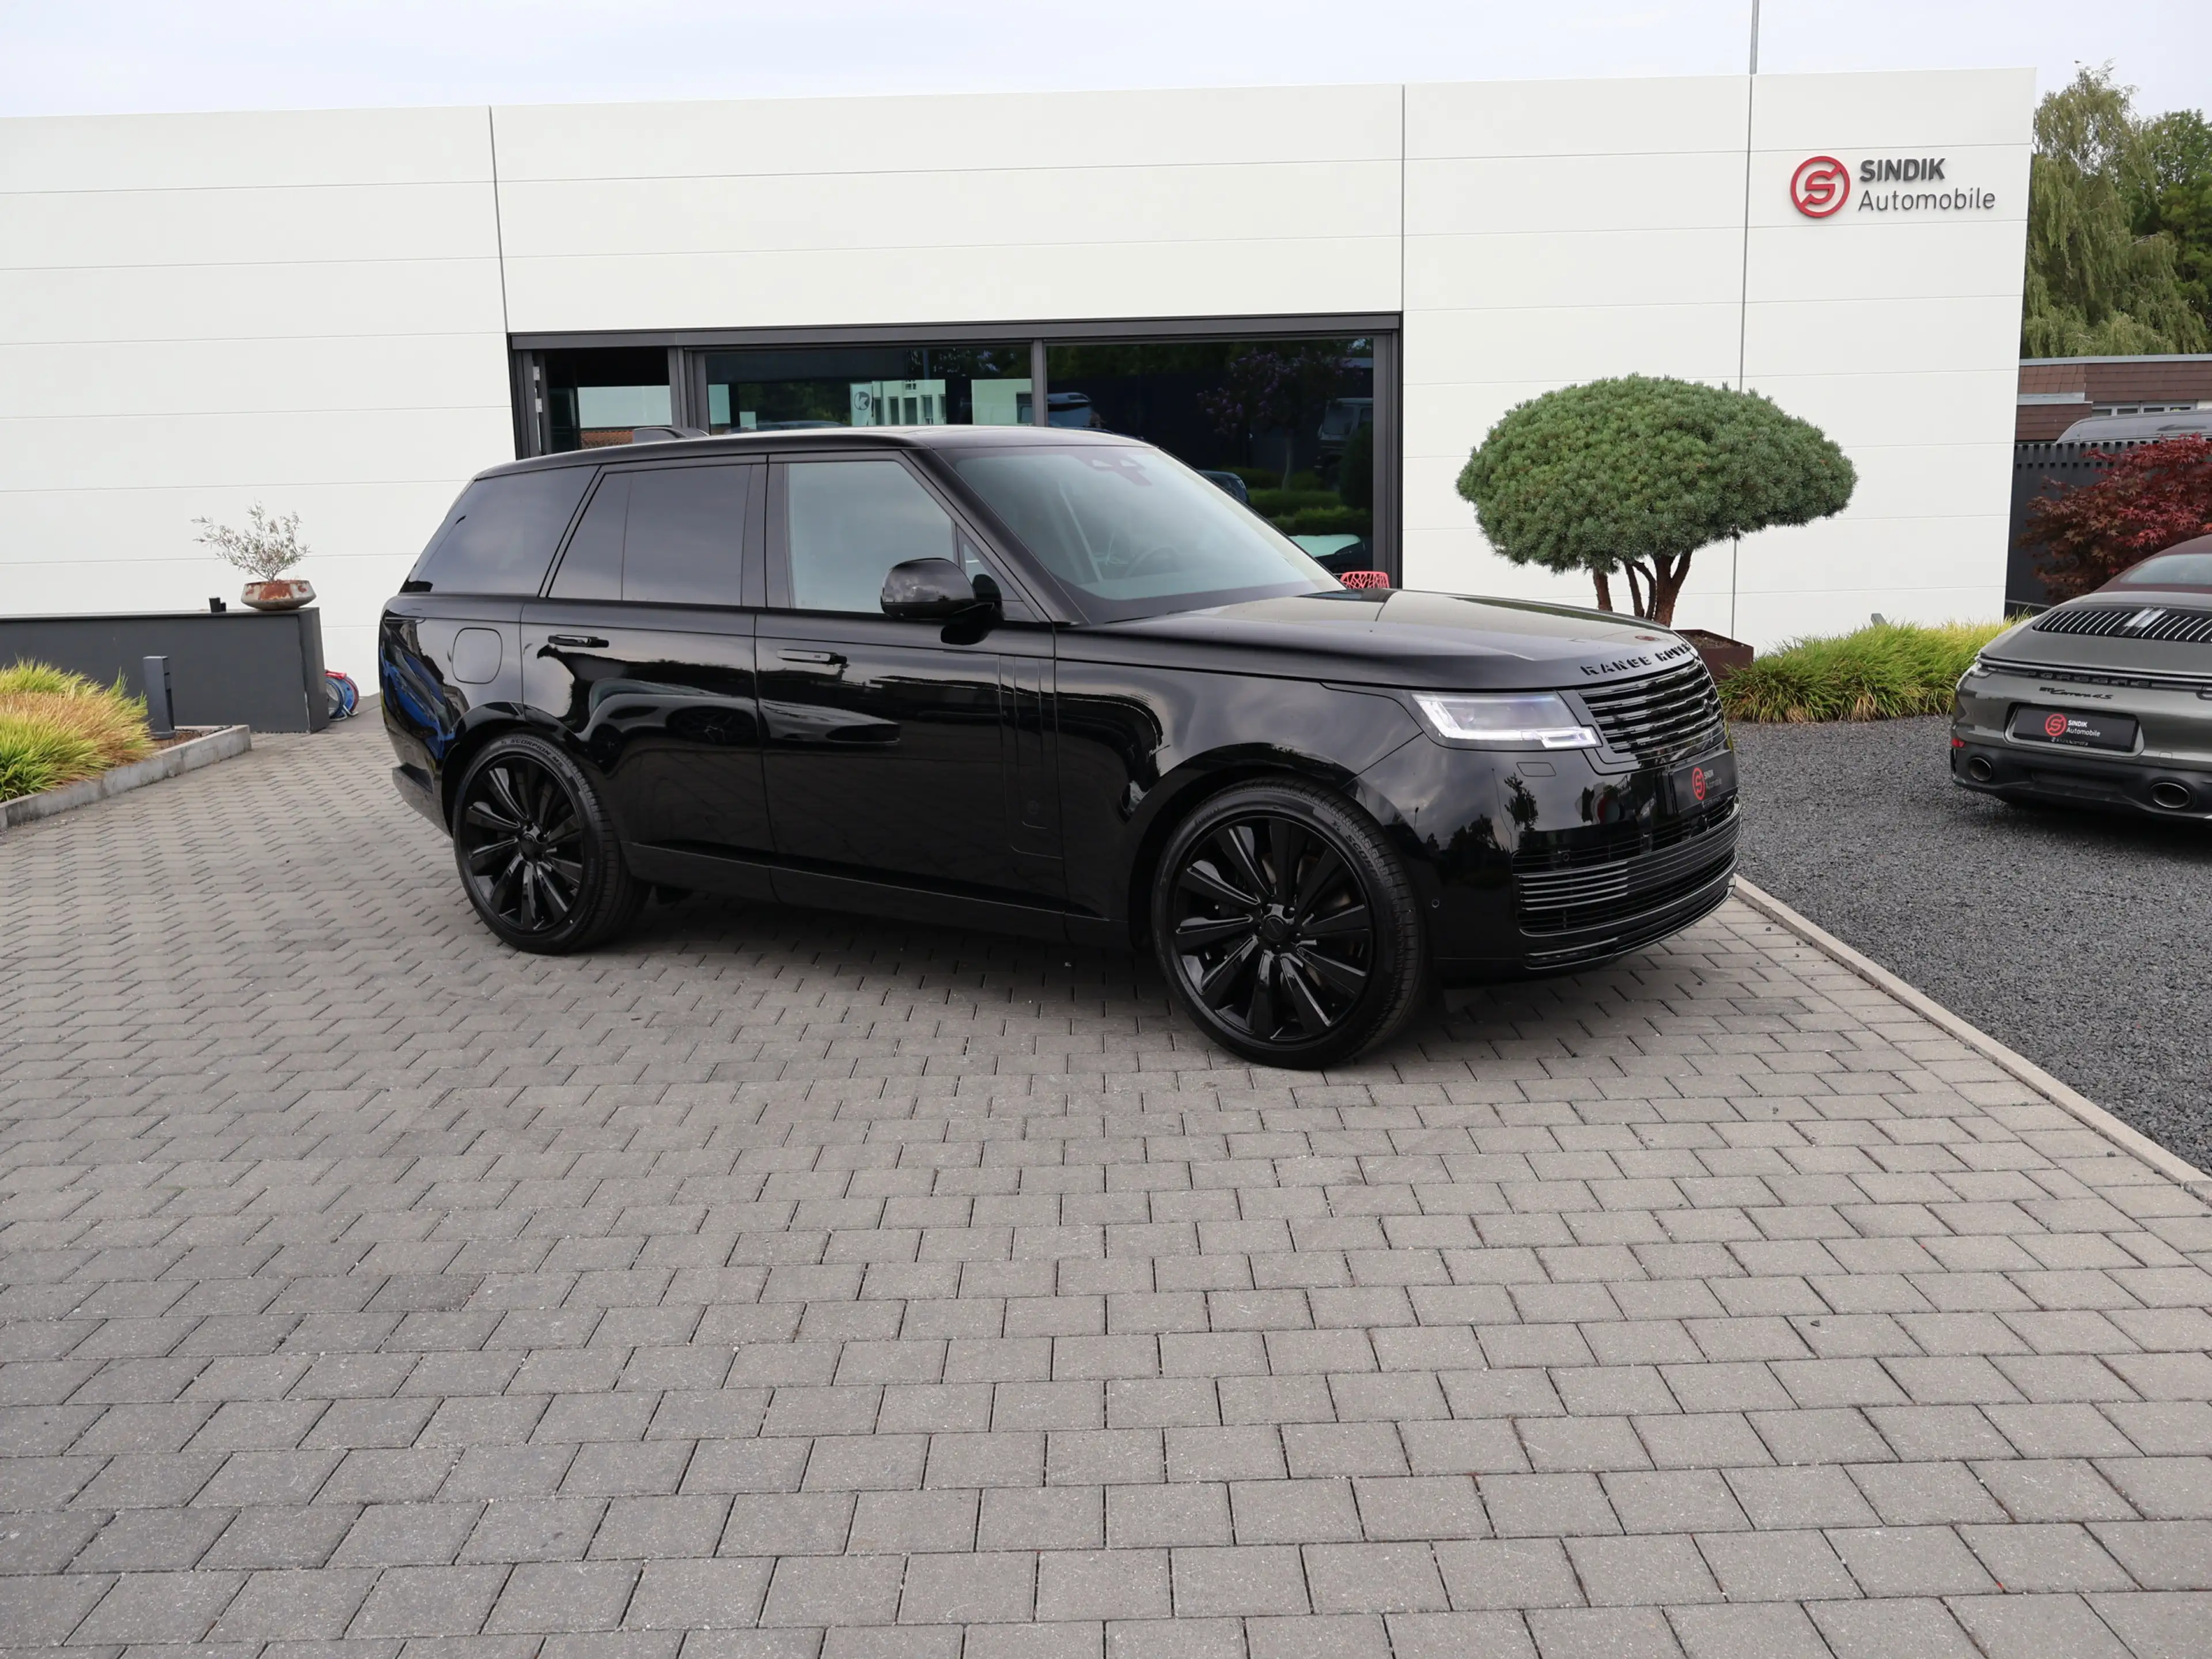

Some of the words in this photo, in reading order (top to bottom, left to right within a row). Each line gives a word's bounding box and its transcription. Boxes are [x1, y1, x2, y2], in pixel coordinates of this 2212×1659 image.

[1859, 158, 1946, 182] SINDIK
[1858, 187, 1995, 211] Automobile
[1580, 656, 1652, 676] RANGE
[2066, 727, 2101, 737] Automobile
[2067, 719, 2088, 728] SINDIK
